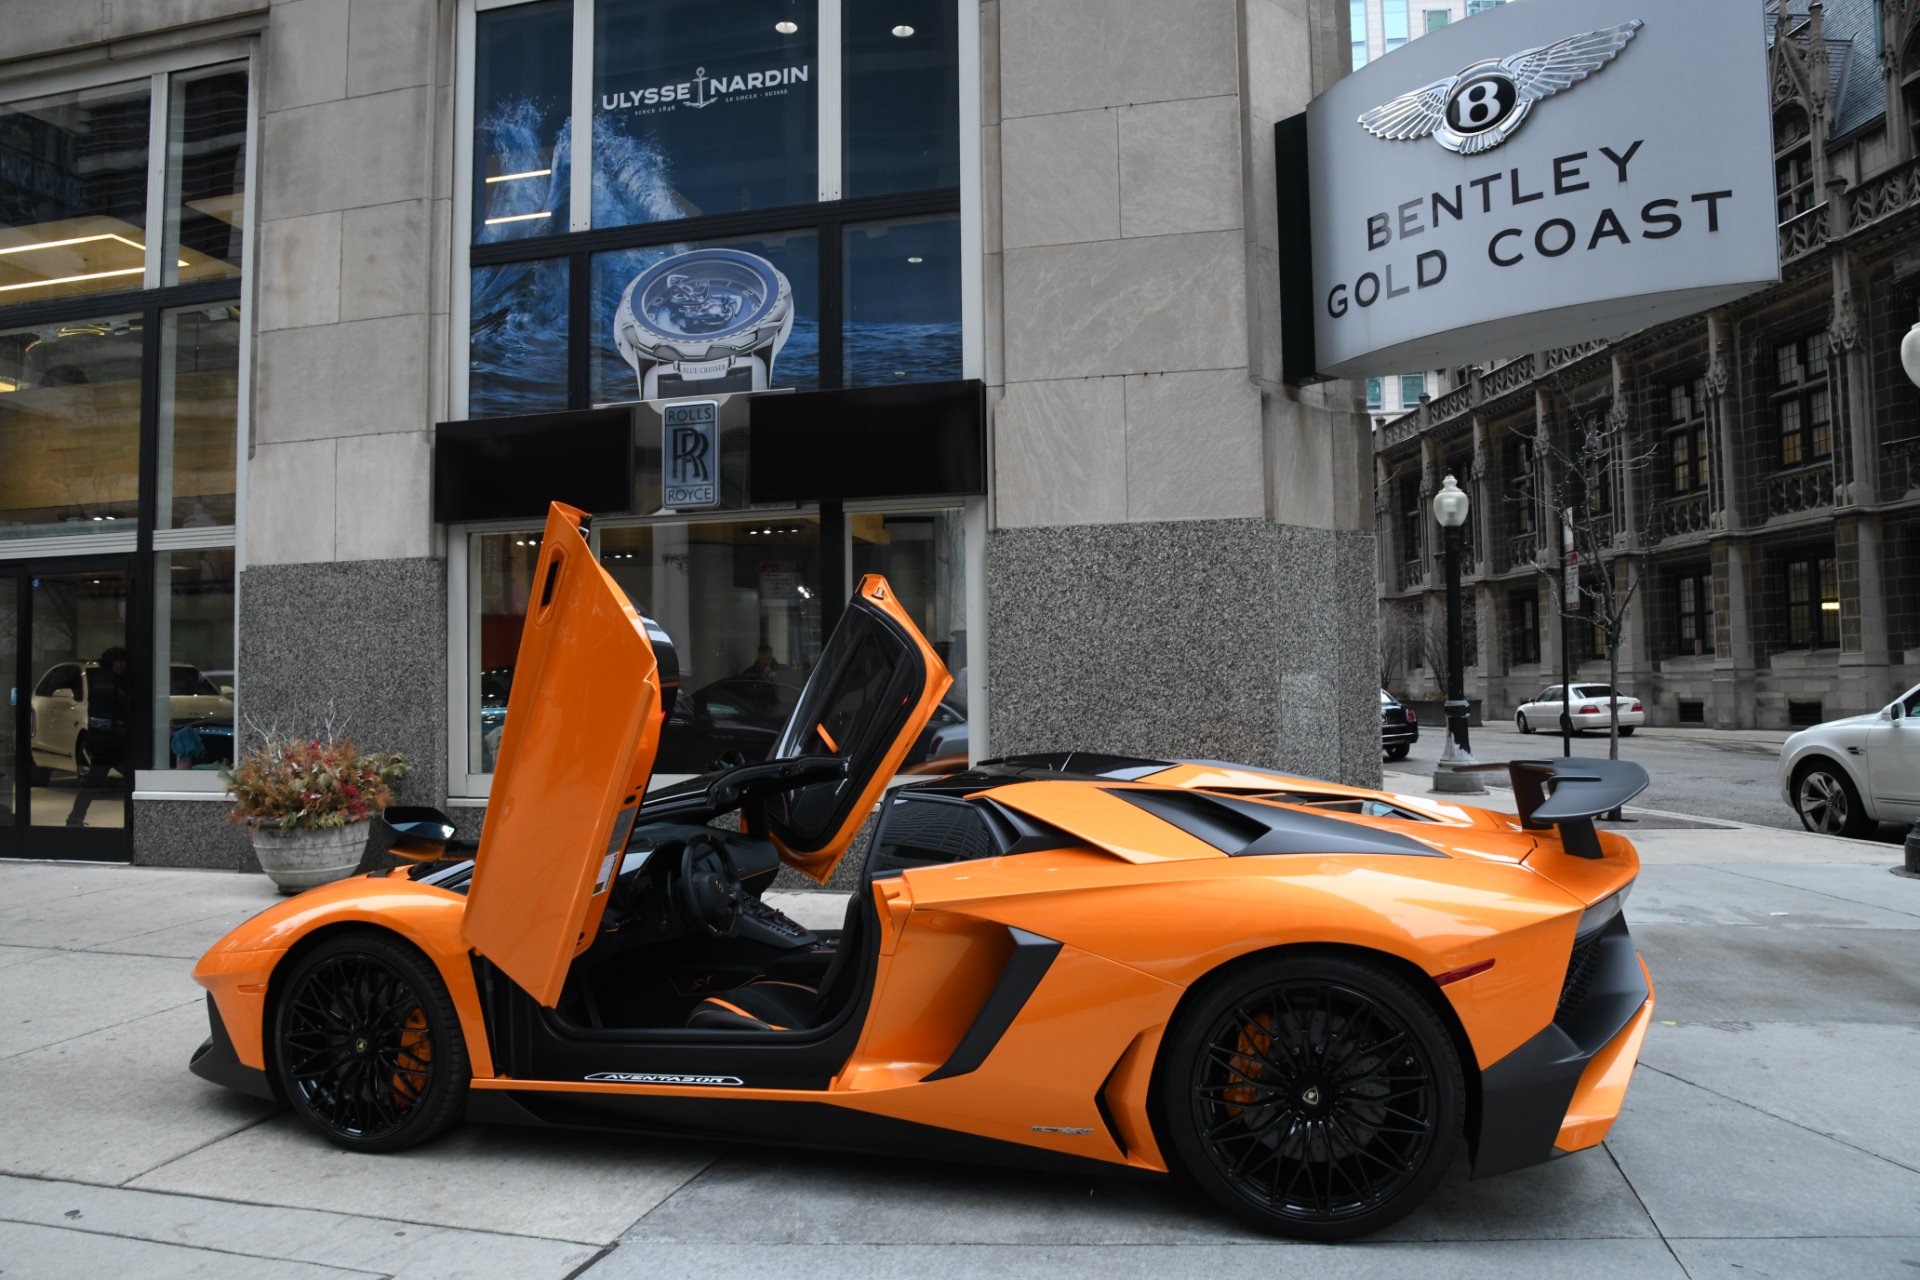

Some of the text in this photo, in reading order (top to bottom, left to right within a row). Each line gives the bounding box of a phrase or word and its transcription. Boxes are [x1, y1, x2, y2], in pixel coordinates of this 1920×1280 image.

[602, 65, 809, 111] ULYSSE NARDIN
[1457, 80, 1502, 128] B
[1367, 140, 1645, 252] BENTLEY
[1327, 189, 1733, 319] GOLD COAST
[668, 407, 712, 422] ROLLS
[668, 487, 712, 502] ROYCE
[604, 1073, 725, 1084] AVENTADOR
